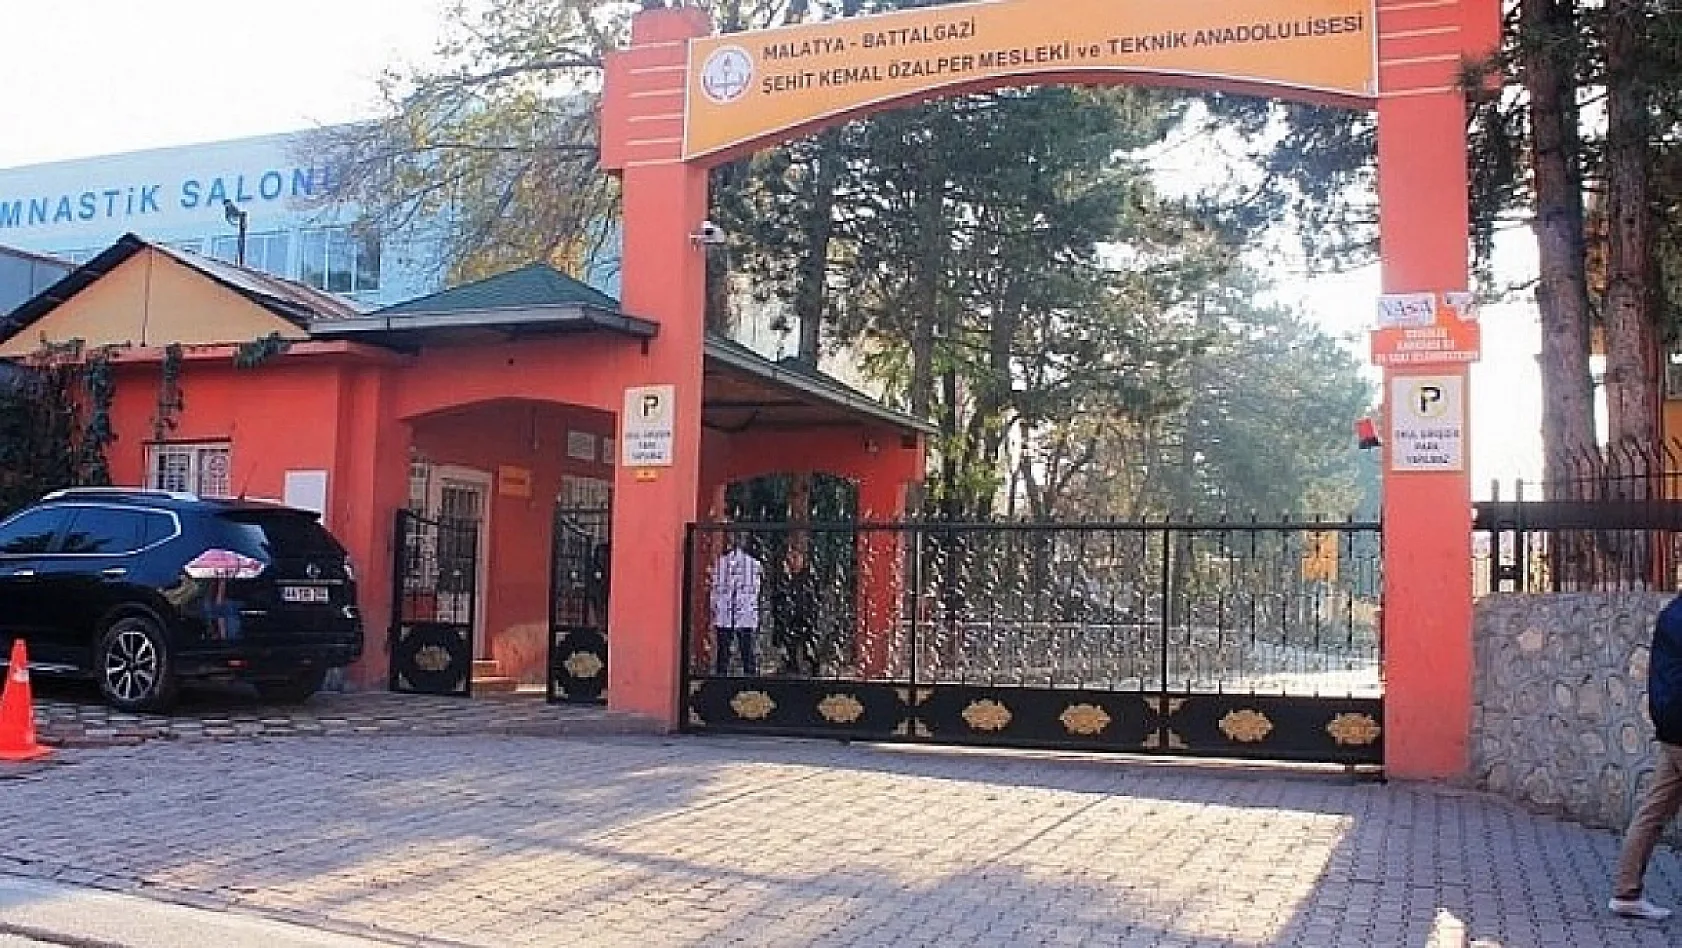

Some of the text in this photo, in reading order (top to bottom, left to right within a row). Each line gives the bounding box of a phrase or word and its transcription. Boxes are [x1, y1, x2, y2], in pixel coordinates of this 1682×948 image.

[762, 37, 845, 60] MALATYA
[862, 16, 975, 48] BATTALGAZİ
[762, 69, 816, 95] ŞEHİT
[819, 66, 883, 86] KEMAL
[888, 53, 974, 78] ÖZALPER
[978, 40, 1069, 67] MESLEKİ
[1077, 45, 1101, 59] ve
[1106, 30, 1188, 55] TEKNİK
[643, 395, 659, 417] P
[1420, 386, 1441, 413] P
